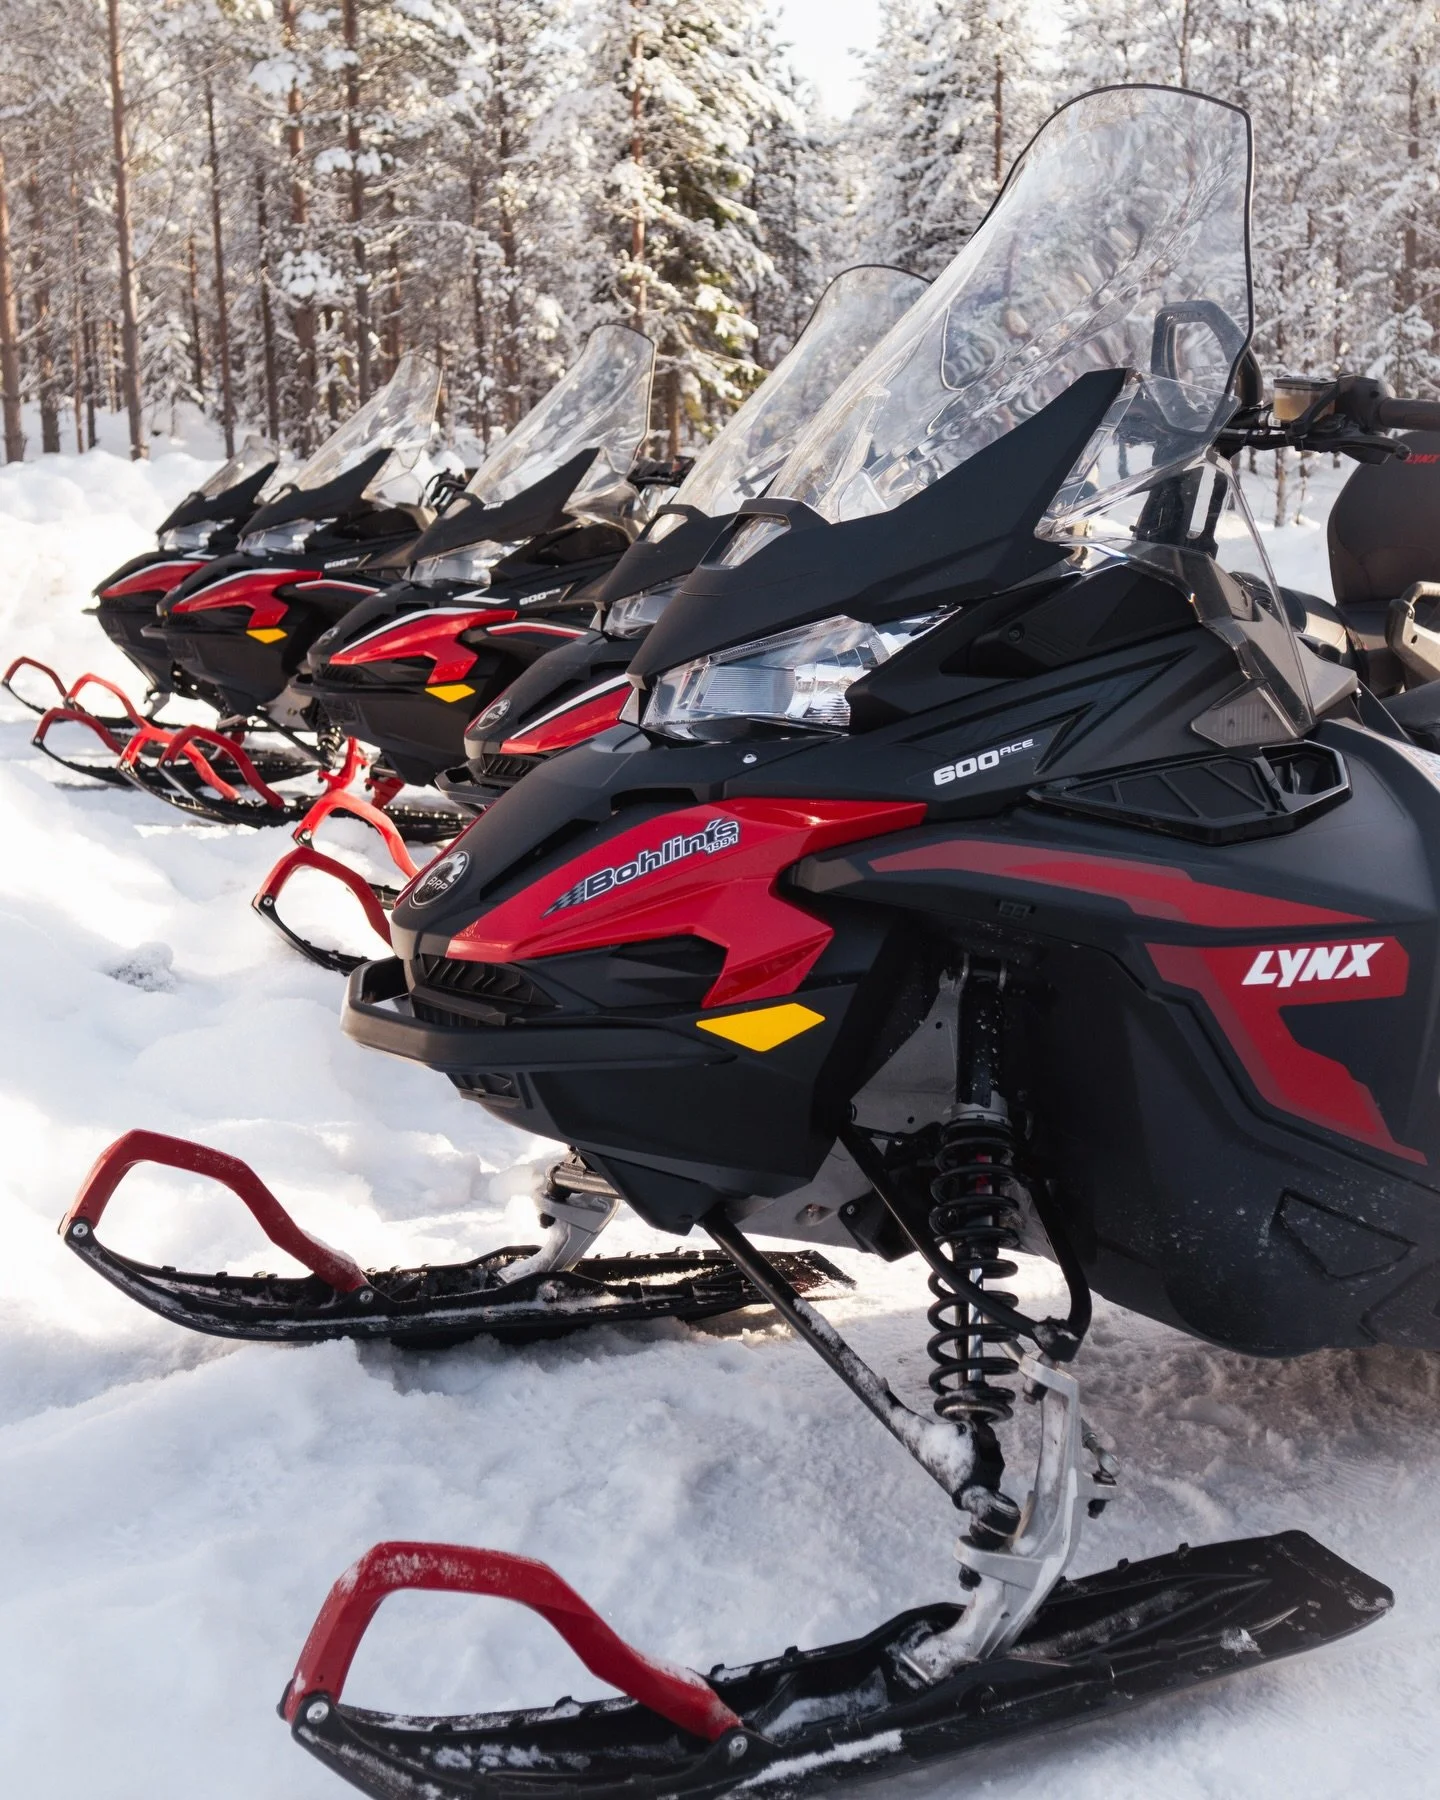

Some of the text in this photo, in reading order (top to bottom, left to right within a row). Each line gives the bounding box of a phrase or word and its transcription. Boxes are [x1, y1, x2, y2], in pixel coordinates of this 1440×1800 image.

[933, 738, 1034, 786] 600 ACE
[584, 817, 740, 901] Bohlin's
[704, 833, 739, 855] 1991
[427, 876, 449, 890] BRP
[1241, 942, 1385, 988] LYNX
